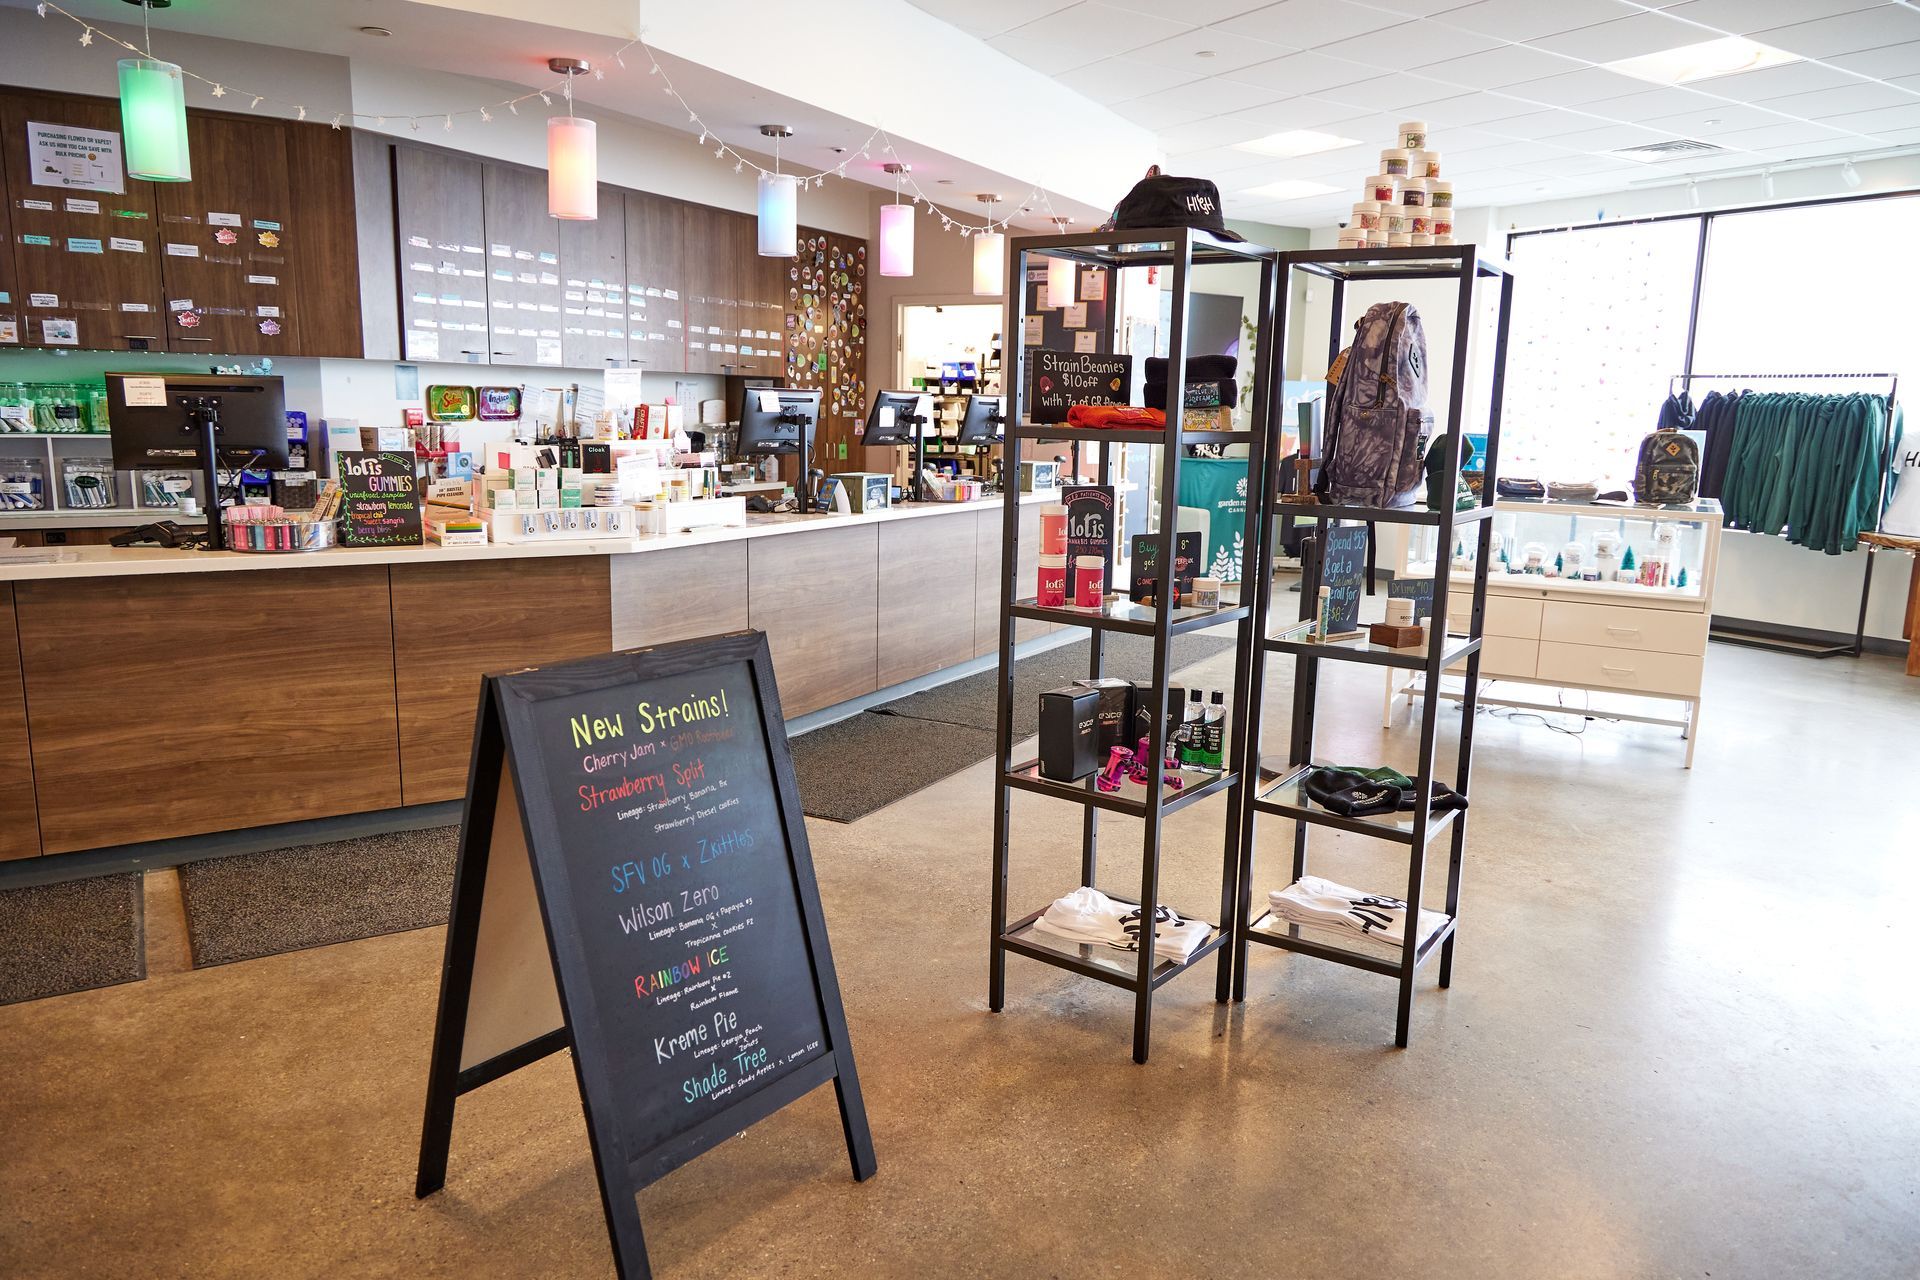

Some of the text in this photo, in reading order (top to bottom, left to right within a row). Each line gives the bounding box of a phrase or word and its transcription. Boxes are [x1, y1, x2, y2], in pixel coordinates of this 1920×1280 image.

[38, 132, 67, 140] PURCHASING
[68, 134, 86, 143] FLOWER
[1043, 354, 1124, 374] Strain Beanies
[1062, 373, 1098, 388] $10 off
[1042, 393, 1063, 406] with
[1080, 396, 1090, 406] of
[345, 457, 382, 476] lotis
[369, 476, 412, 492] GUMMIES
[356, 501, 414, 514] strawberry lemonade
[1218, 499, 1240, 508] garden
[351, 512, 372, 521] tropical
[382, 517, 405, 528] sangria
[1070, 513, 1104, 538] lotis
[357, 526, 375, 536] berry
[1327, 530, 1352, 555] Spend
[1139, 542, 1159, 559] Buy
[1144, 560, 1154, 570] get
[1330, 556, 1345, 582] get
[1346, 560, 1352, 573] a
[1344, 586, 1357, 605] for
[571, 689, 729, 748] New Strains!
[583, 751, 627, 773] Cherry
[630, 742, 656, 760] Jam
[578, 758, 705, 811] Strawberry Split
[617, 806, 646, 821] Lineage:
[647, 793, 686, 813] Strawberry
[688, 784, 716, 800] Banana
[654, 797, 740, 833] Strawberry Diesel cookies
[611, 861, 646, 894] SFV
[652, 852, 671, 878] OG
[697, 828, 754, 864] Zkittles
[618, 885, 719, 934] Wilson Zero
[649, 925, 678, 940] Lineage:
[679, 917, 704, 931] Banana
[720, 902, 745, 916] Papaya
[685, 933, 721, 948] Tropicanna
[723, 923, 745, 936] cookies
[634, 945, 729, 999] RAINBOW ICE
[656, 991, 684, 1006] Lineage:
[684, 980, 710, 994] Rainbow
[712, 975, 721, 984] Pie
[690, 987, 739, 1011] Rainbow Flame
[654, 1011, 737, 1064] Kreme Pie
[693, 1024, 762, 1059] Lineage: Georgia Peach
[683, 1047, 767, 1103] Shade Tree
[711, 1084, 736, 1100] Lineage:
[737, 1074, 756, 1088] Shady
[756, 1062, 775, 1076] Apples
[788, 1048, 805, 1062] Lemon
